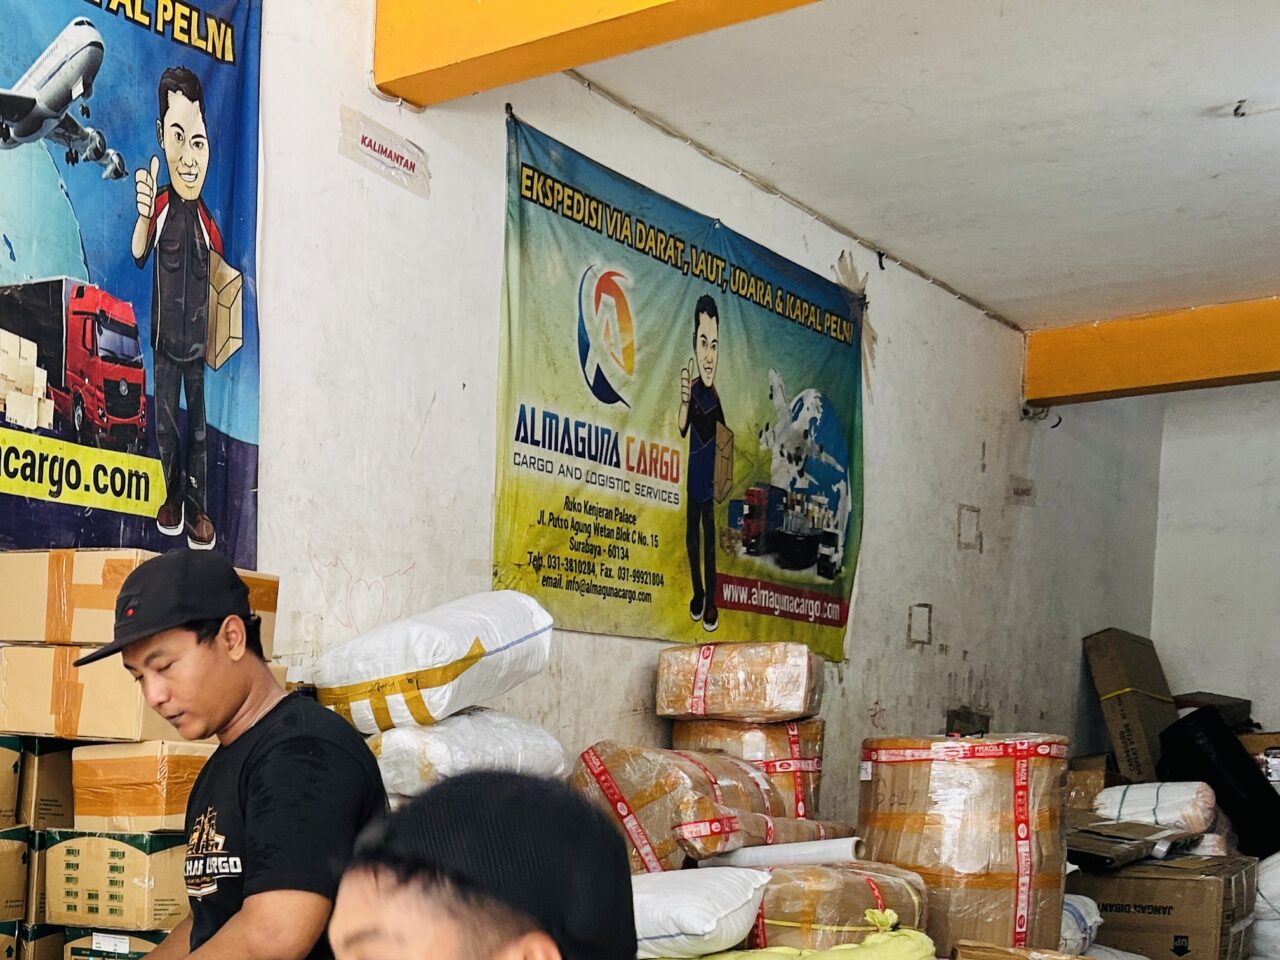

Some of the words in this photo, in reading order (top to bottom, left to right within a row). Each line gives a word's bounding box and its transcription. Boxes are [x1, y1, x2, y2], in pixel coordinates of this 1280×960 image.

[155, 0, 234, 63] PELNI
[359, 133, 417, 174] KALIMANTAN
[520, 164, 603, 234] EKSPEDISI
[605, 203, 634, 248] VIA
[634, 220, 689, 275] DARAT,
[690, 245, 728, 293] LAUT,
[729, 264, 774, 309] UDARA
[774, 289, 784, 312] &
[785, 289, 823, 333] KAPAL
[823, 312, 854, 347] PELNI
[514, 403, 621, 469] ALMAGUNA
[625, 434, 681, 484] CARGO
[513, 452, 554, 474] CARGO
[557, 463, 582, 481] AND
[585, 469, 631, 494] LOGISTIC
[634, 482, 680, 506] SERVICES
[537, 509, 547, 526] Jl.
[548, 511, 569, 530] Putro
[570, 516, 592, 539] Agung
[593, 521, 615, 540] Wetan
[615, 526, 630, 543] Blok
[631, 530, 637, 545] C
[637, 531, 649, 547] No.
[650, 534, 659, 549] 15
[563, 495, 582, 513] Ruko
[583, 499, 613, 521] Kenjeran
[614, 506, 637, 525] Palace
[569, 536, 602, 559] Surabaya
[607, 544, 629, 561] 60134
[541, 574, 564, 590] email.
[565, 575, 652, 604] info@almagunacargo.com
[599, 563, 614, 579] Fax.
[617, 566, 665, 587] 031-99921804
[722, 580, 841, 621] www.almagunacargo.com
[974, 744, 1004, 753] FRAGILE
[1174, 938, 1188, 947] UP
